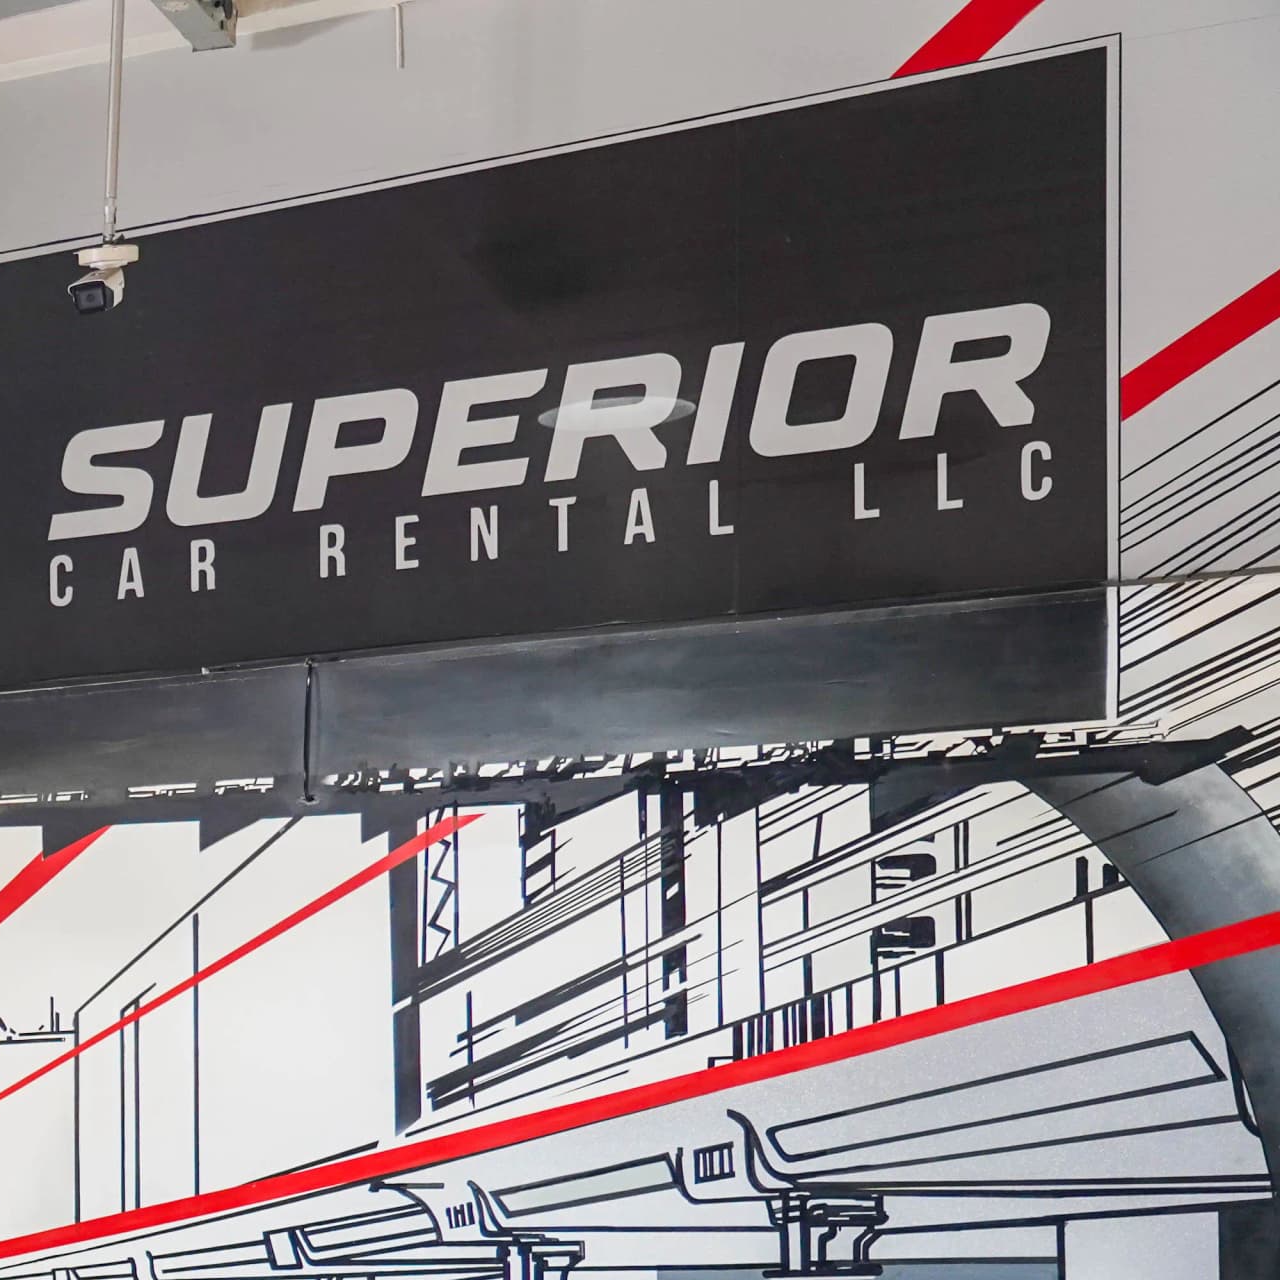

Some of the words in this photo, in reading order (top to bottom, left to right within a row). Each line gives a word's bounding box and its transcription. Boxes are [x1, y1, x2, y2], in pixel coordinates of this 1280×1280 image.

[48, 303, 1051, 540] SUPERIOR
[50, 538, 216, 607] CAR
[320, 479, 735, 579] RENTAL
[855, 441, 1052, 520] LLC
